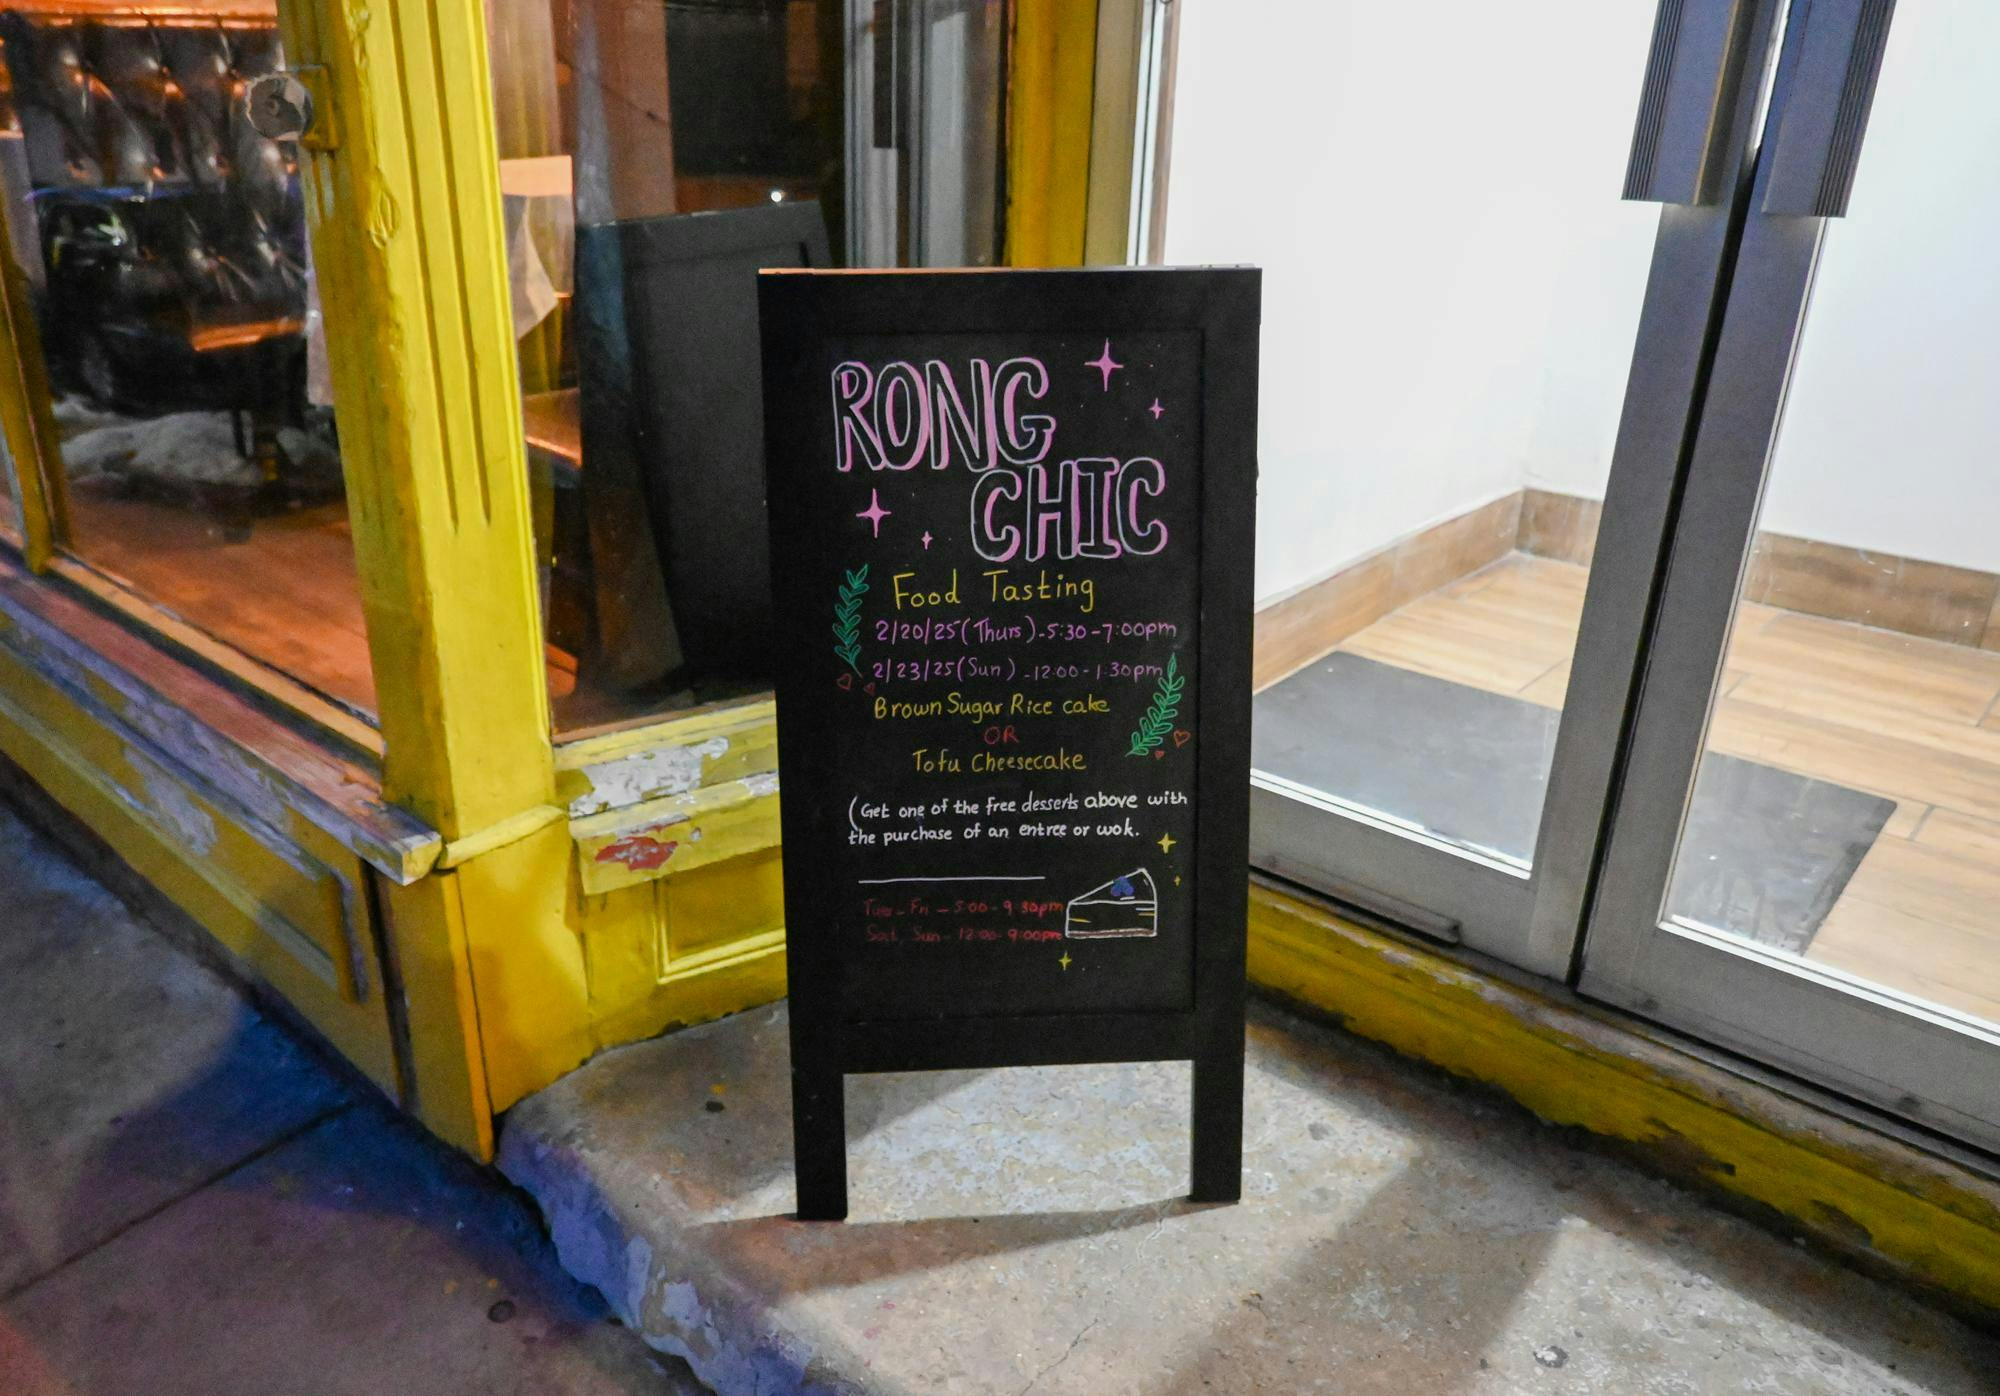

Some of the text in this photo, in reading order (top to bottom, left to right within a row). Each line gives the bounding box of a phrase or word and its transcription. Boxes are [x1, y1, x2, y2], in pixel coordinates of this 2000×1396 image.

[832, 356, 1057, 473] RONG
[970, 457, 1168, 563] CHIC
[893, 569, 1095, 613] Food Tasting
[874, 692, 1110, 724] Brown Sugar Rice cake
[984, 725, 1019, 745] OR
[913, 747, 1087, 773] Tofu Cheesecake
[849, 790, 1188, 832] (Get one of the free desserts above with
[848, 817, 1139, 847] the purchase of an entree or wok.
